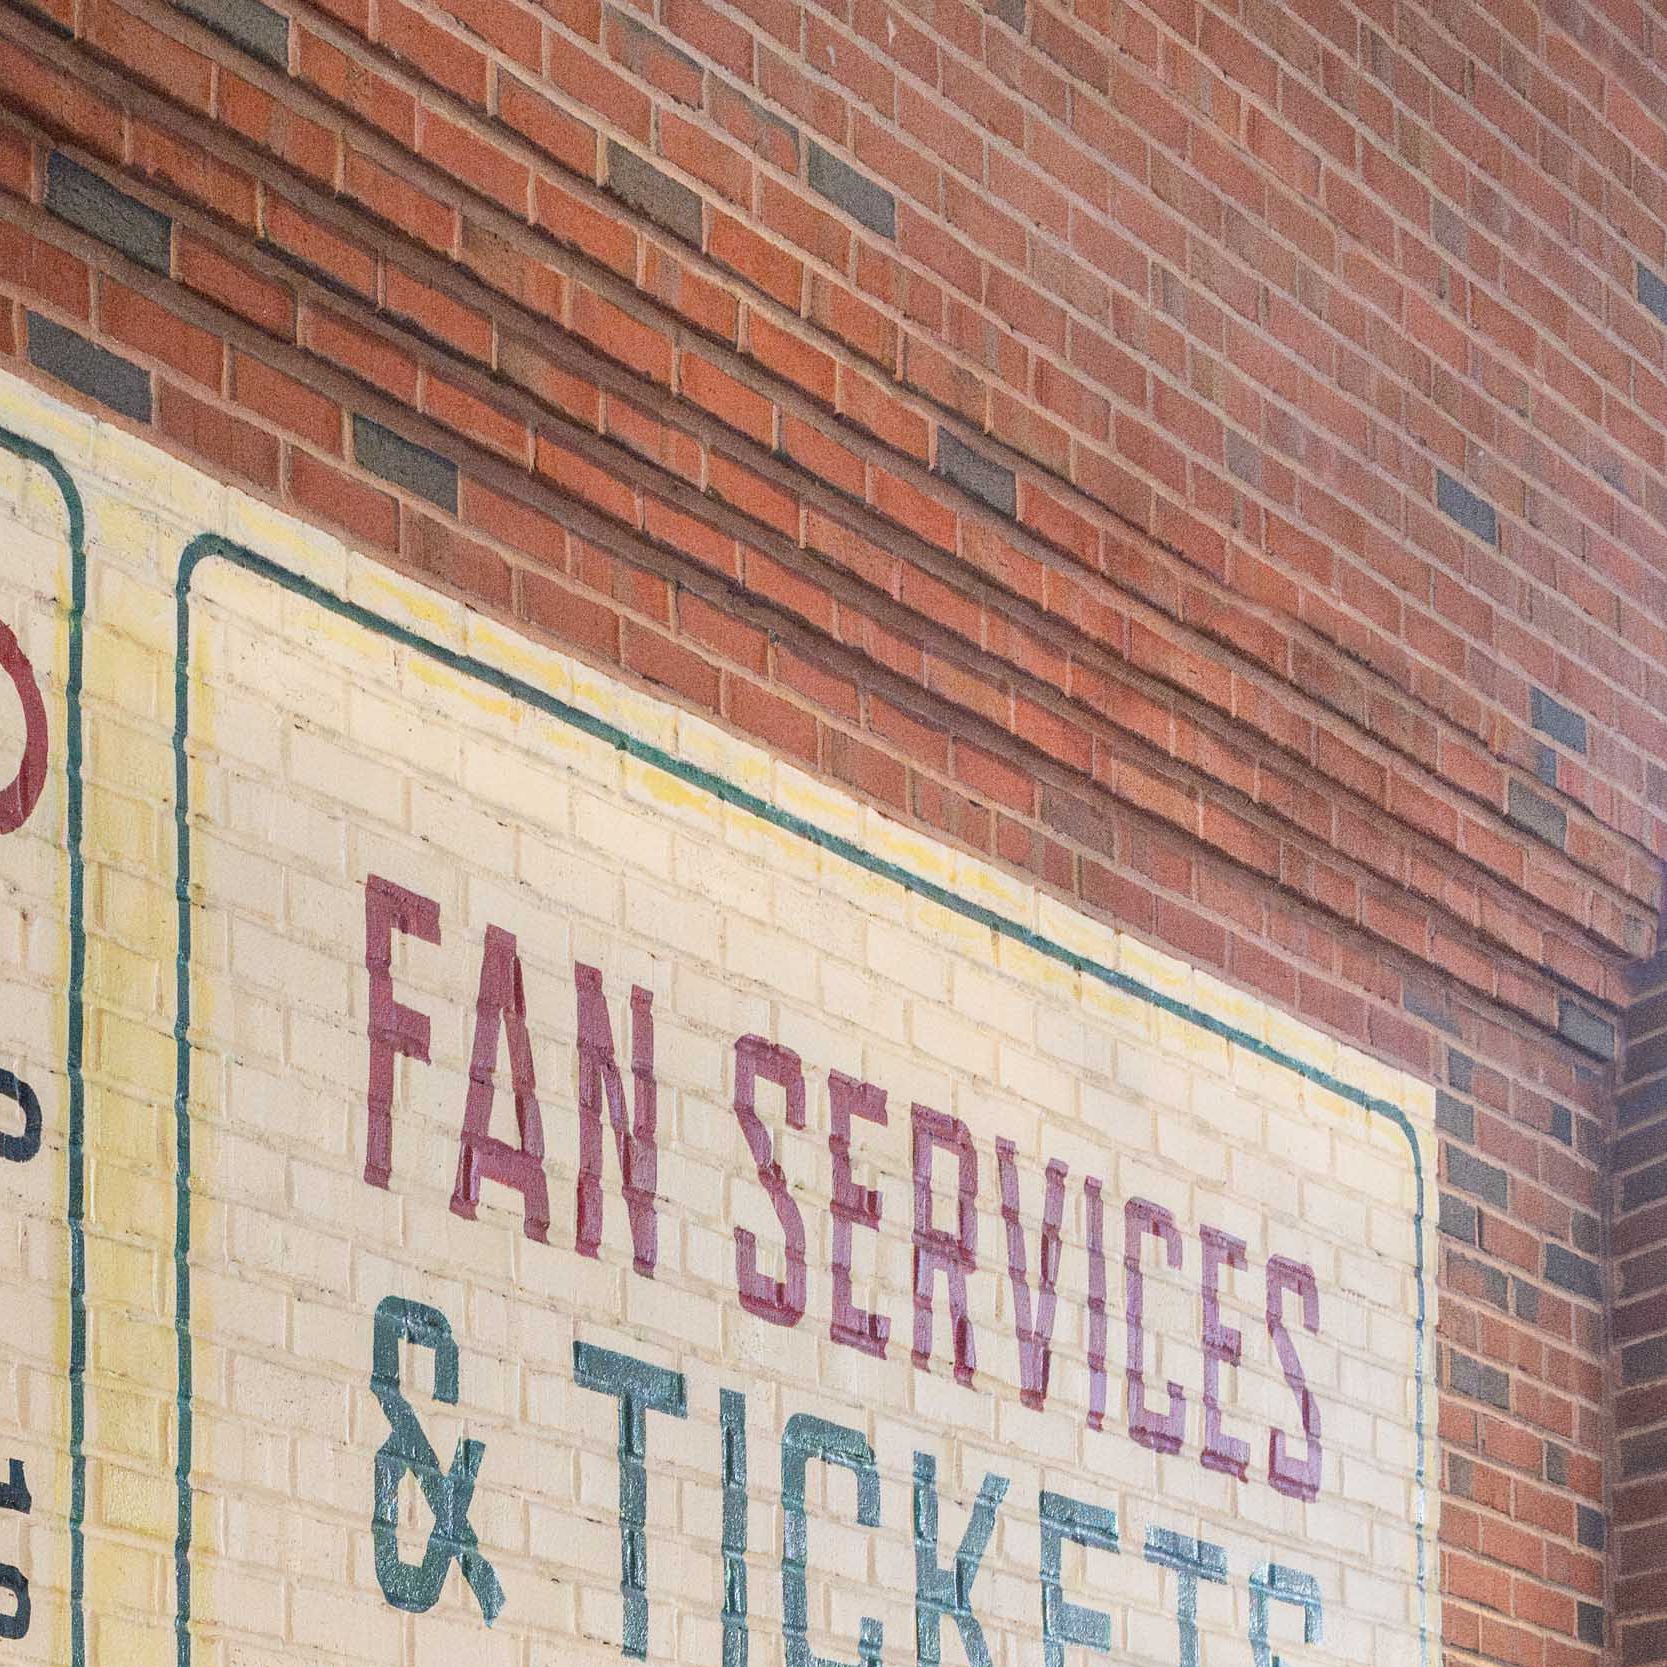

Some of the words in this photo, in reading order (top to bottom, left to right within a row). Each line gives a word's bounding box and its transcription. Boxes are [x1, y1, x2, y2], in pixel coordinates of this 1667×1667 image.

[363, 874, 656, 1278] FAN
[734, 1033, 1321, 1503] SERVICES
[369, 1294, 505, 1629] &
